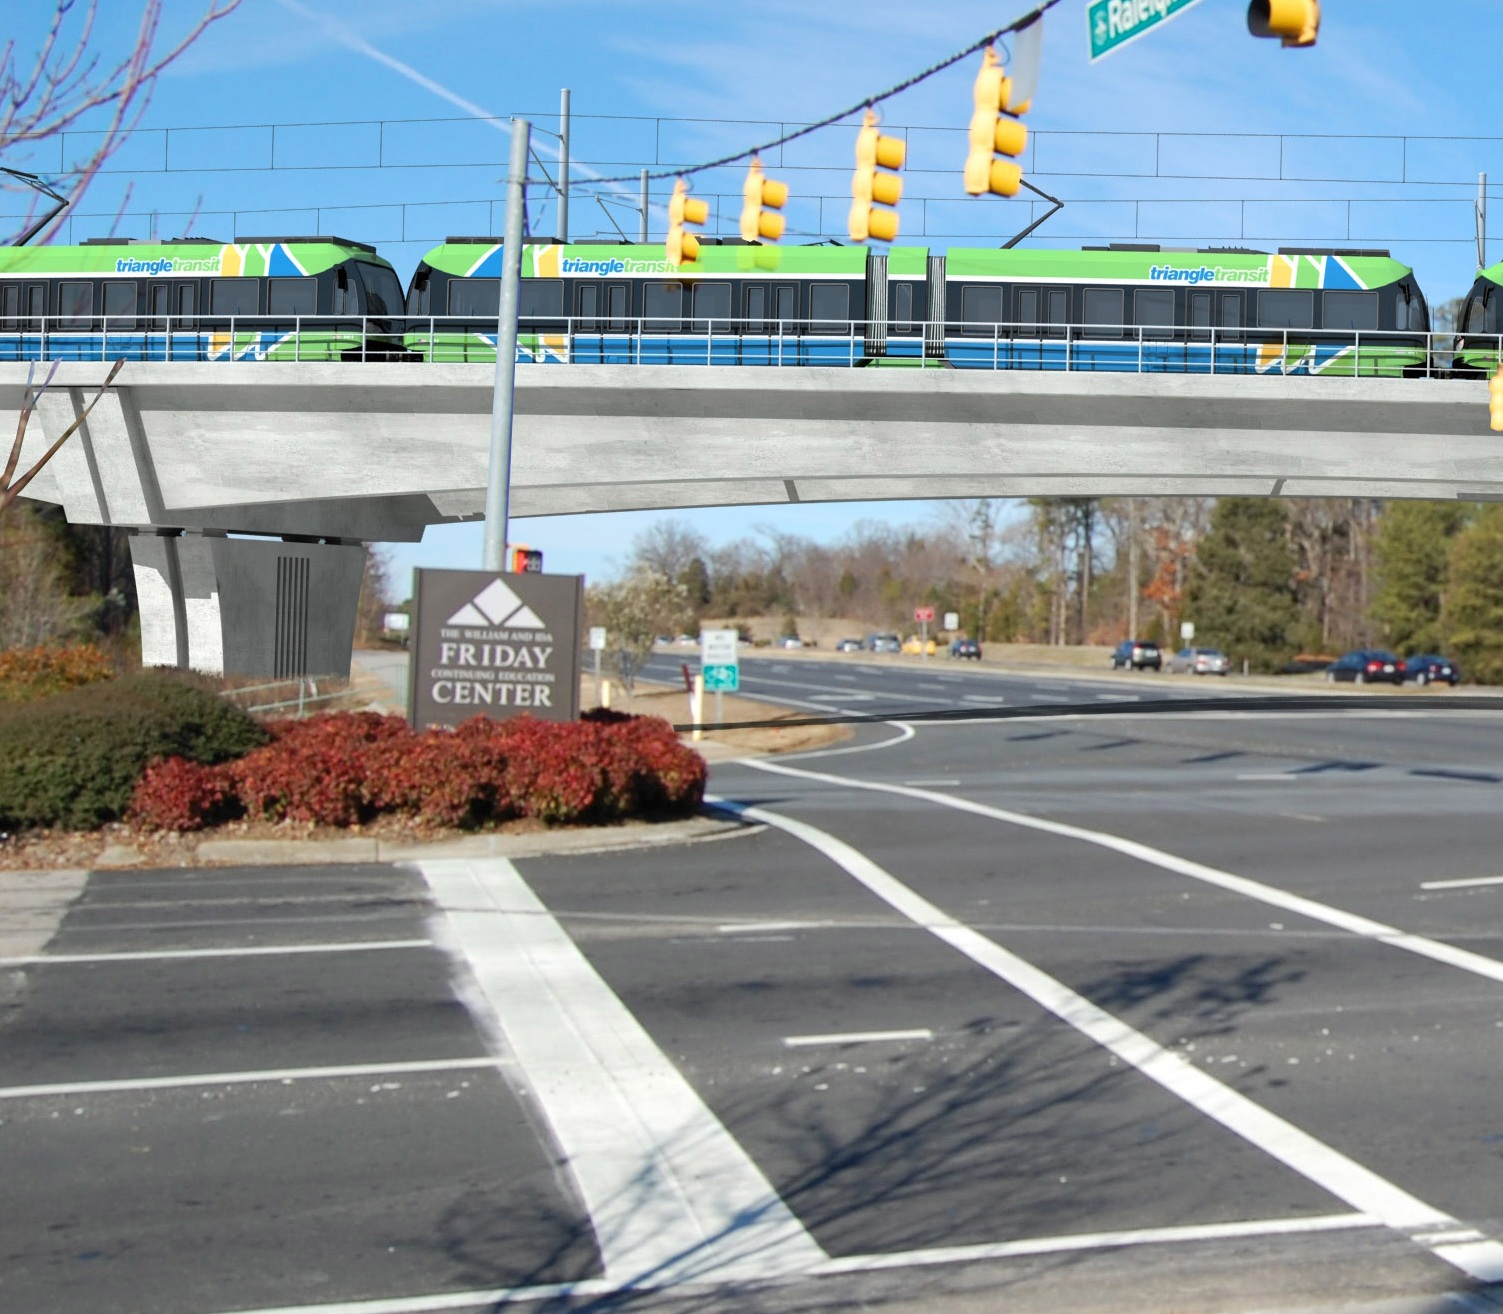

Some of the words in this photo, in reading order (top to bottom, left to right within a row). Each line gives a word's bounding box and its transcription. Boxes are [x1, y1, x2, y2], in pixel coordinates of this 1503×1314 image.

[1107, 0, 1178, 38] Raleg
[116, 258, 221, 276] triangletransit
[1150, 266, 1269, 284] triangletransit
[440, 629, 460, 639] THE
[464, 629, 509, 640] WILLIAM
[511, 631, 533, 642] AND
[440, 642, 553, 669] FRIDAY
[431, 669, 495, 681] CONTINUING
[498, 671, 555, 682] EDUCATION
[431, 680, 553, 707] CENTER
